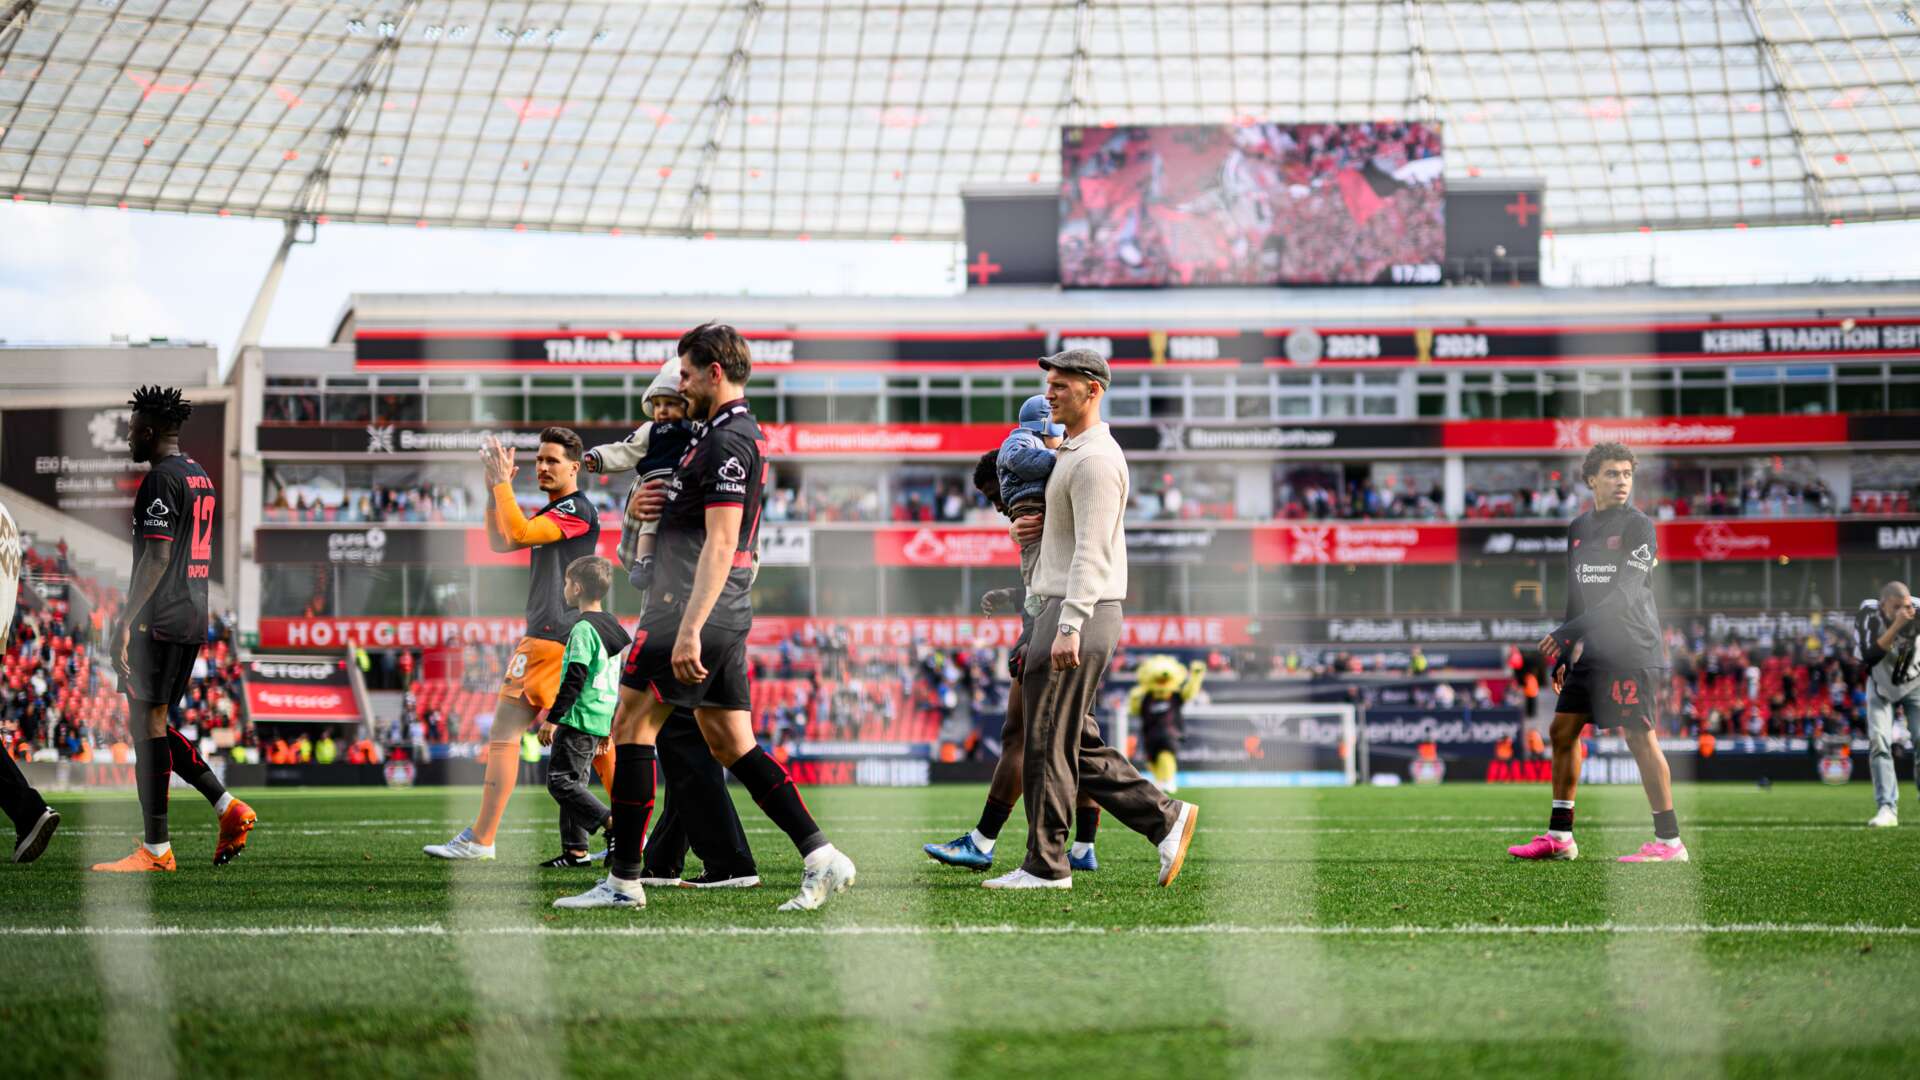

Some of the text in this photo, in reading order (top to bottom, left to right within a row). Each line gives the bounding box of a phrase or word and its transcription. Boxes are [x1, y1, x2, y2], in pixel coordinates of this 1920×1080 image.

[1327, 334, 1380, 358] 2024
[1435, 334, 1488, 358] 2024
[1704, 328, 1766, 353] KEINE
[1767, 326, 1879, 351] TRADITION
[191, 495, 216, 560] 12
[1582, 563, 1617, 574] Barmenia
[1582, 574, 1612, 584] Gothaer
[1611, 680, 1639, 705] 42
